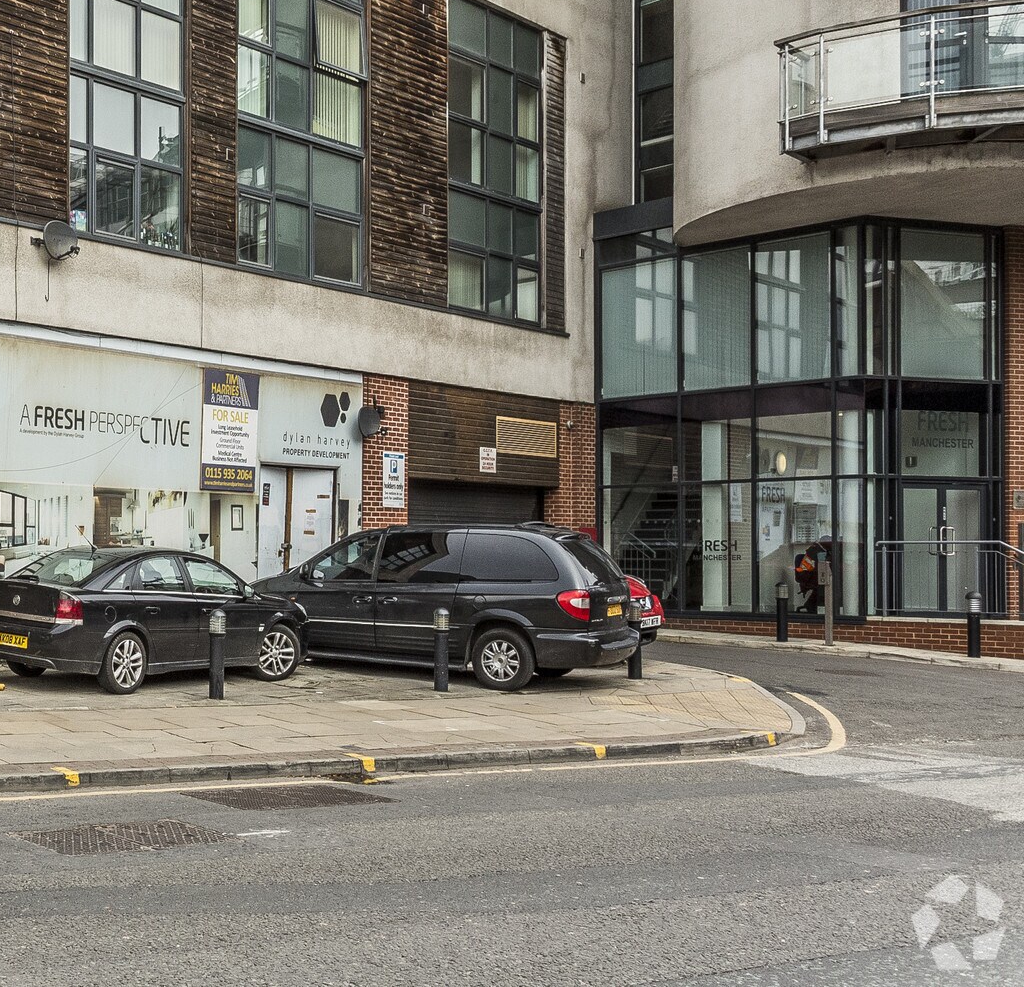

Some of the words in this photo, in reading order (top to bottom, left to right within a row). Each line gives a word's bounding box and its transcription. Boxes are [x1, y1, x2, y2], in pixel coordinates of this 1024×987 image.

[226, 374, 238, 385] TIM
[211, 382, 240, 396] HARRIES
[216, 394, 242, 406] PARTNERS
[20, 404, 30, 426] A
[34, 406, 85, 430] FRESH
[212, 409, 228, 422] FOR
[230, 410, 249, 424] SALE
[917, 410, 969, 432] FRESH
[282, 431, 310, 444] dylan
[318, 434, 350, 449] harvey
[912, 437, 974, 448] MANCHESTER
[282, 448, 311, 456] PROPERTY
[312, 450, 350, 460] DEVELOPMENT
[205, 467, 222, 478] 0115
[223, 468, 236, 480] 935
[236, 470, 252, 480] 2064
[761, 486, 786, 504] FRESH
